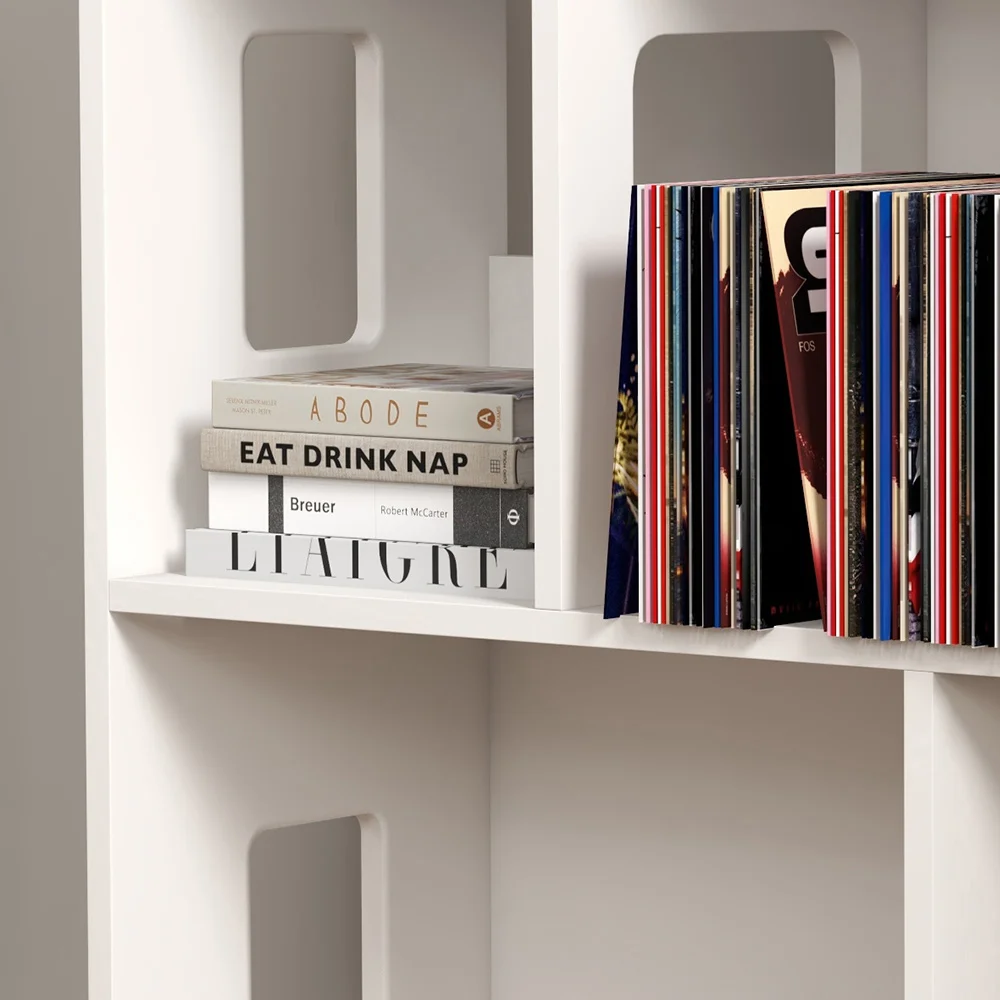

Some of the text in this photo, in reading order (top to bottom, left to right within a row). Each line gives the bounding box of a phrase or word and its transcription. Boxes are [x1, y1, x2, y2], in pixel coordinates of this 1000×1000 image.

[798, 340, 816, 352] FOS
[310, 395, 429, 428] ABODE
[240, 441, 468, 475] EAT DRINK NAP
[290, 497, 448, 518] Breuer Robert McCarter
